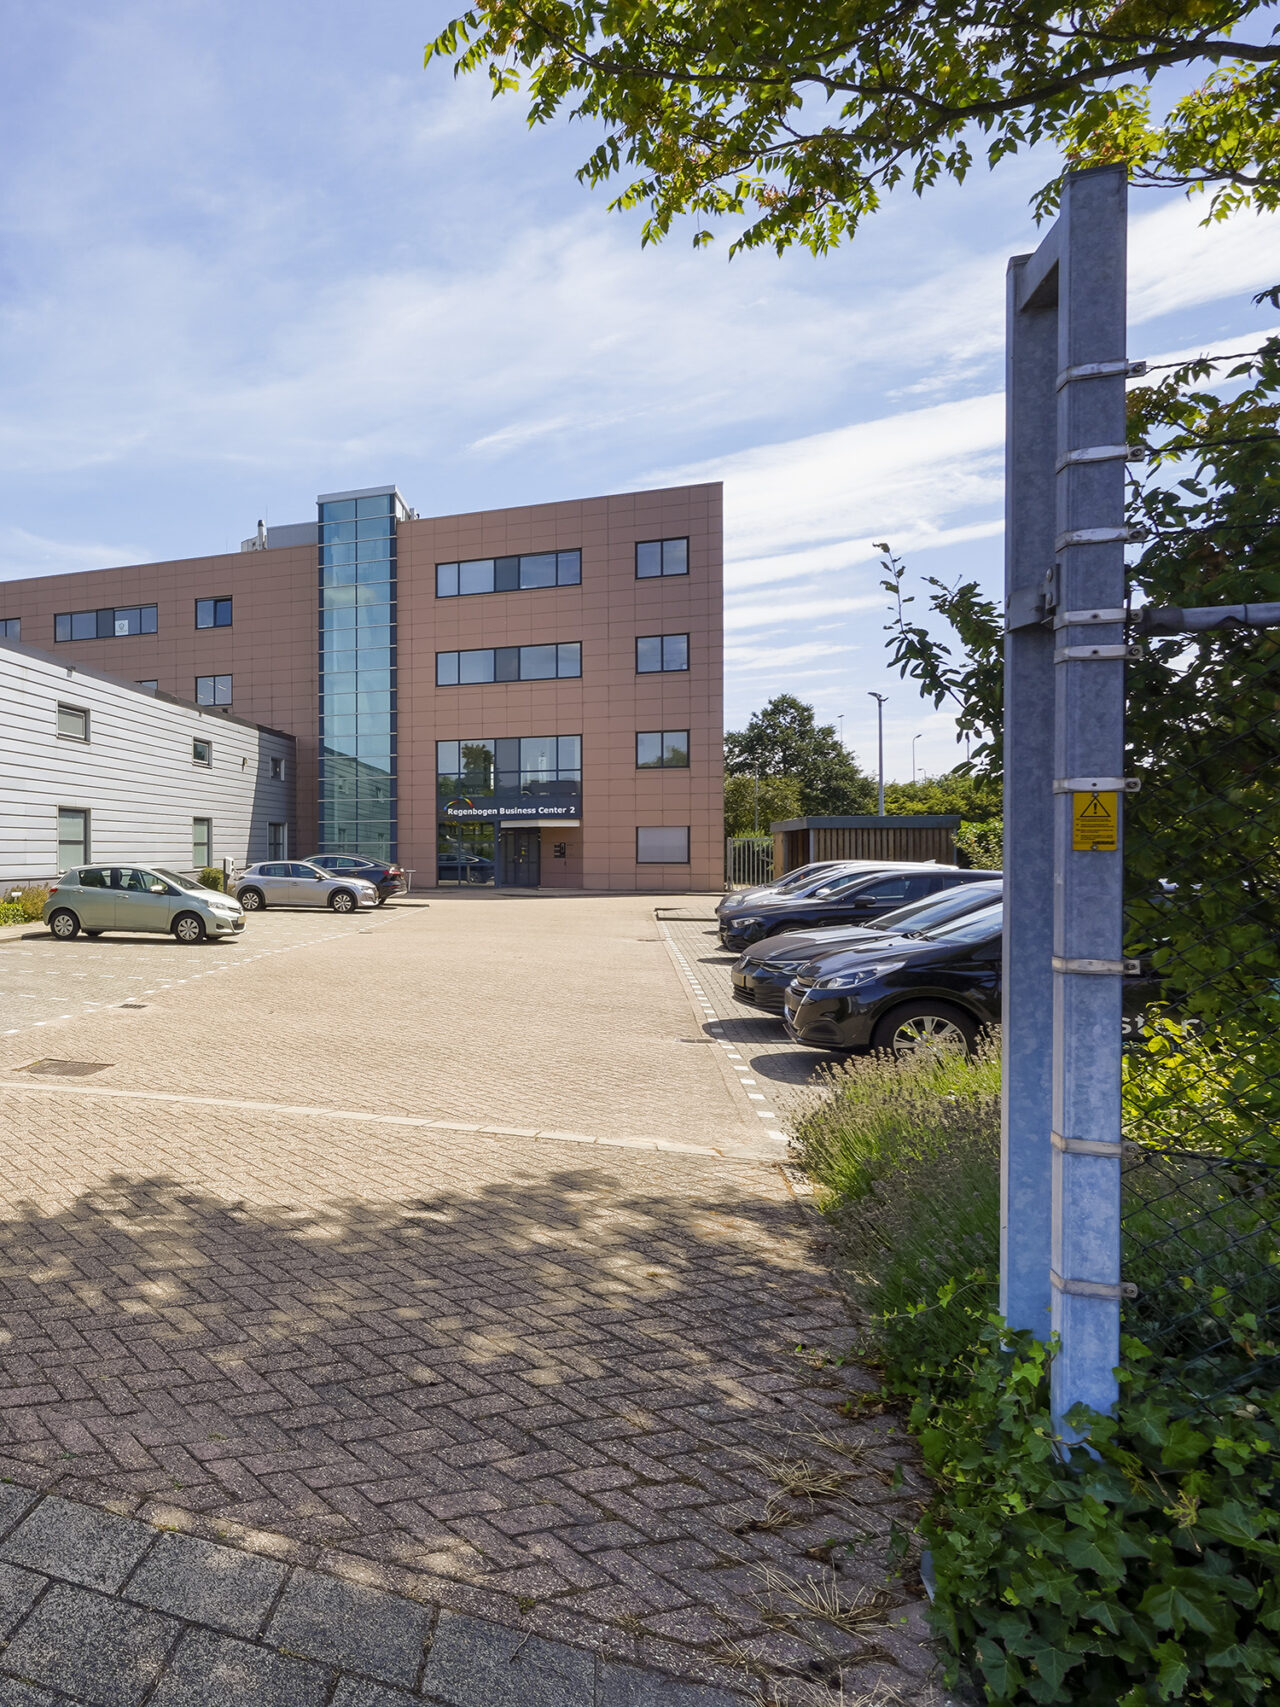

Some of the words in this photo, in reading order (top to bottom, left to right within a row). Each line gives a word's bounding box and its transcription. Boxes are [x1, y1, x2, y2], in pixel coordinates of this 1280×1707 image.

[447, 808, 498, 816] Regenbogen
[499, 806, 537, 815] Business
[538, 806, 567, 814] Center
[570, 806, 576, 814] 2
